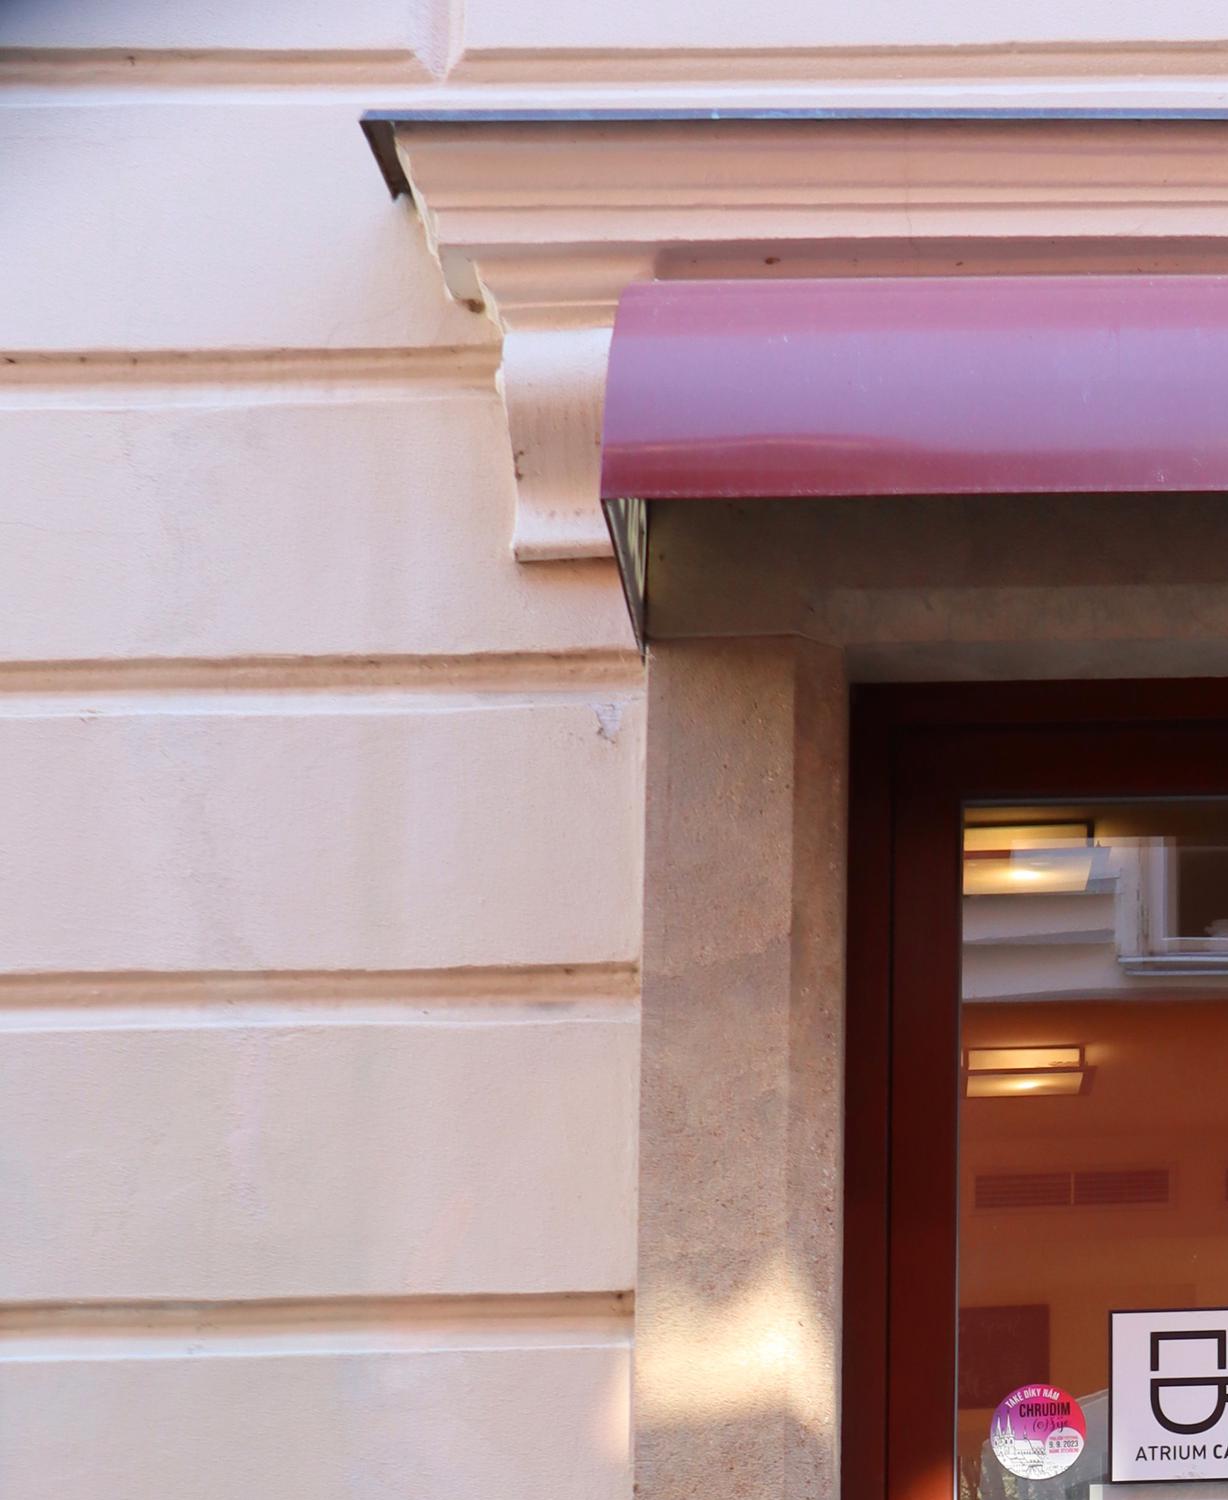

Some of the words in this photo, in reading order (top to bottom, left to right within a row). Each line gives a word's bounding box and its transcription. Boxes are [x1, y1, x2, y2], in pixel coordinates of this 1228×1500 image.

[1019, 1402, 1071, 1417] CHRUDIM
[1063, 1440, 1079, 1448] 2023
[1135, 1444, 1207, 1461] ATRIUM
